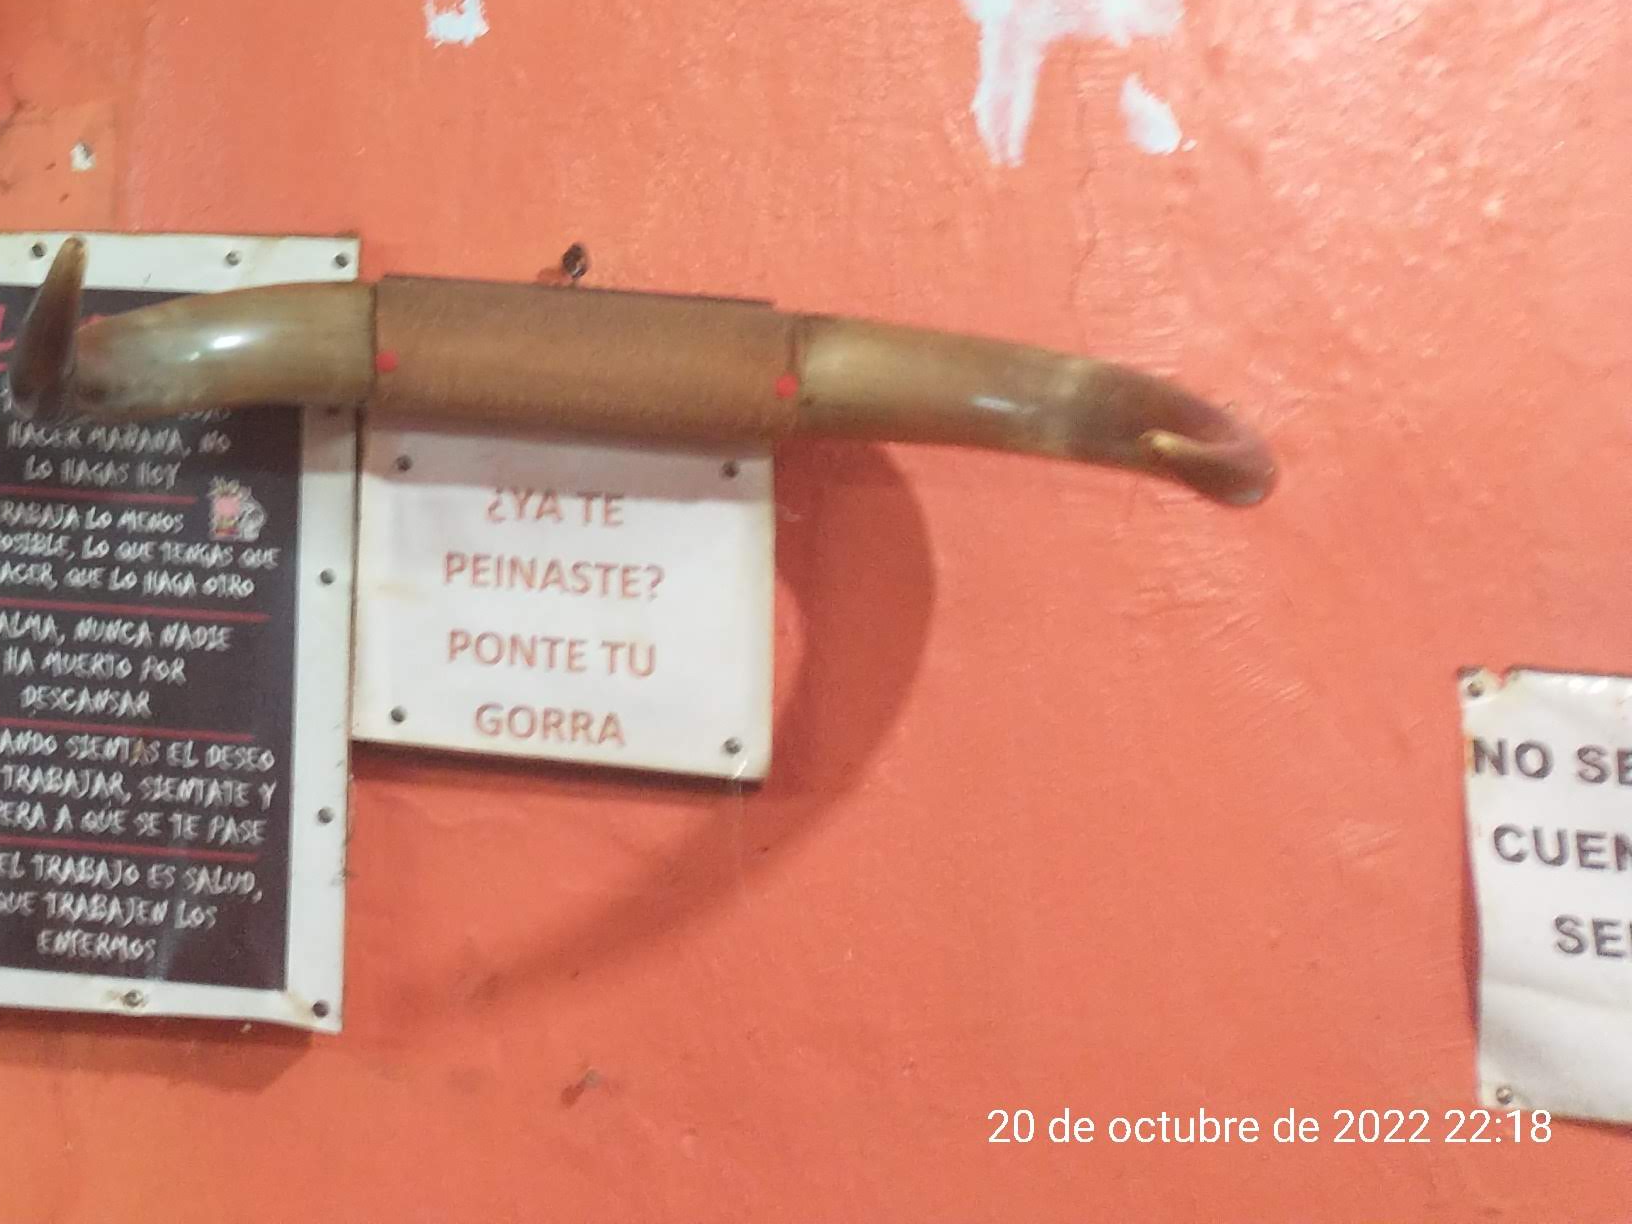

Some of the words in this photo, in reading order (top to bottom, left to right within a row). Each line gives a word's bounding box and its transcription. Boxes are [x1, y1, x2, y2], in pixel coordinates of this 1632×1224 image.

[8, 420, 82, 450] HACER
[198, 429, 231, 454] NO
[24, 455, 54, 481] LO
[60, 457, 130, 487] HAGAS
[136, 461, 182, 490] HOY
[84, 505, 114, 530] LO
[117, 508, 185, 534] MENOS
[486, 485, 565, 524] ¿YA
[575, 490, 626, 528] TE
[81, 535, 111, 560] LO
[114, 540, 157, 563] QUE
[160, 541, 235, 568] TENGAS
[238, 546, 282, 569] QUE
[64, 566, 107, 590] QUE
[108, 566, 138, 591] LO
[142, 569, 197, 597] HAGA
[202, 573, 256, 598] OTRO
[442, 551, 666, 602] PEINASTE?
[73, 617, 155, 649] NUNCA
[159, 620, 235, 652] NADIE
[446, 628, 588, 675] PONTE
[600, 639, 659, 679] TU
[2, 646, 36, 675] HA
[40, 649, 134, 680] MUERTO
[139, 655, 188, 687] POR
[20, 685, 154, 719] DESCANSAR
[473, 702, 627, 749] GORRA
[65, 733, 161, 767] SIENTAS
[167, 739, 200, 769] EL
[205, 743, 277, 773] DESEO
[1472, 736, 1554, 779] NO
[258, 779, 277, 812] Y
[52, 803, 73, 833] A
[81, 808, 130, 835] QUE
[133, 812, 164, 837] SE
[169, 812, 202, 840] TE
[206, 815, 268, 846] PASE
[30, 851, 141, 890] TRABAJO
[146, 863, 177, 890] ES
[42, 890, 168, 928] TRABAJEN
[174, 899, 218, 929] LOS
[37, 929, 157, 962] ENFERMOS
[1553, 913, 1632, 960] SE
